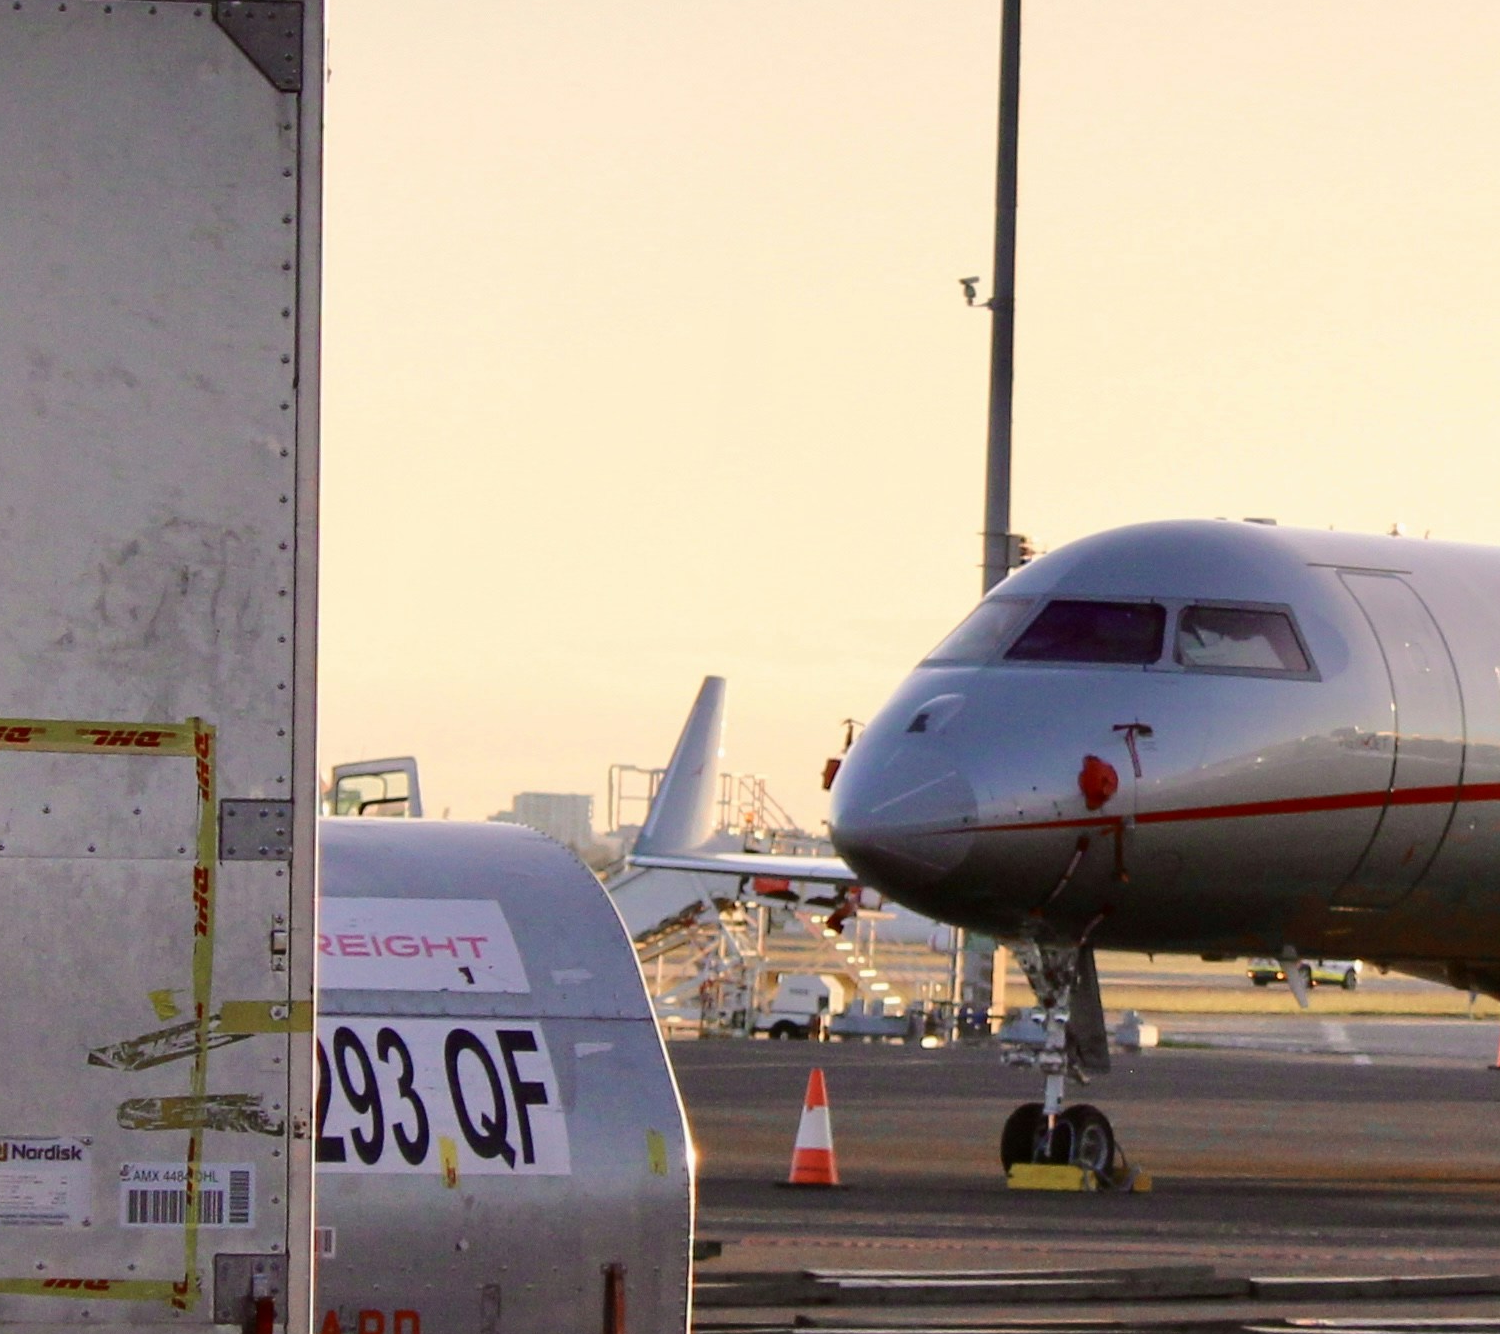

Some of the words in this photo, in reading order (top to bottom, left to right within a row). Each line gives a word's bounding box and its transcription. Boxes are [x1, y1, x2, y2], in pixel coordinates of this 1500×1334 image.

[91, 729, 165, 747] DHL
[444, 1028, 548, 1170] QF
[11, 1144, 82, 1161] Nordisk
[133, 1170, 160, 1182] AMX
